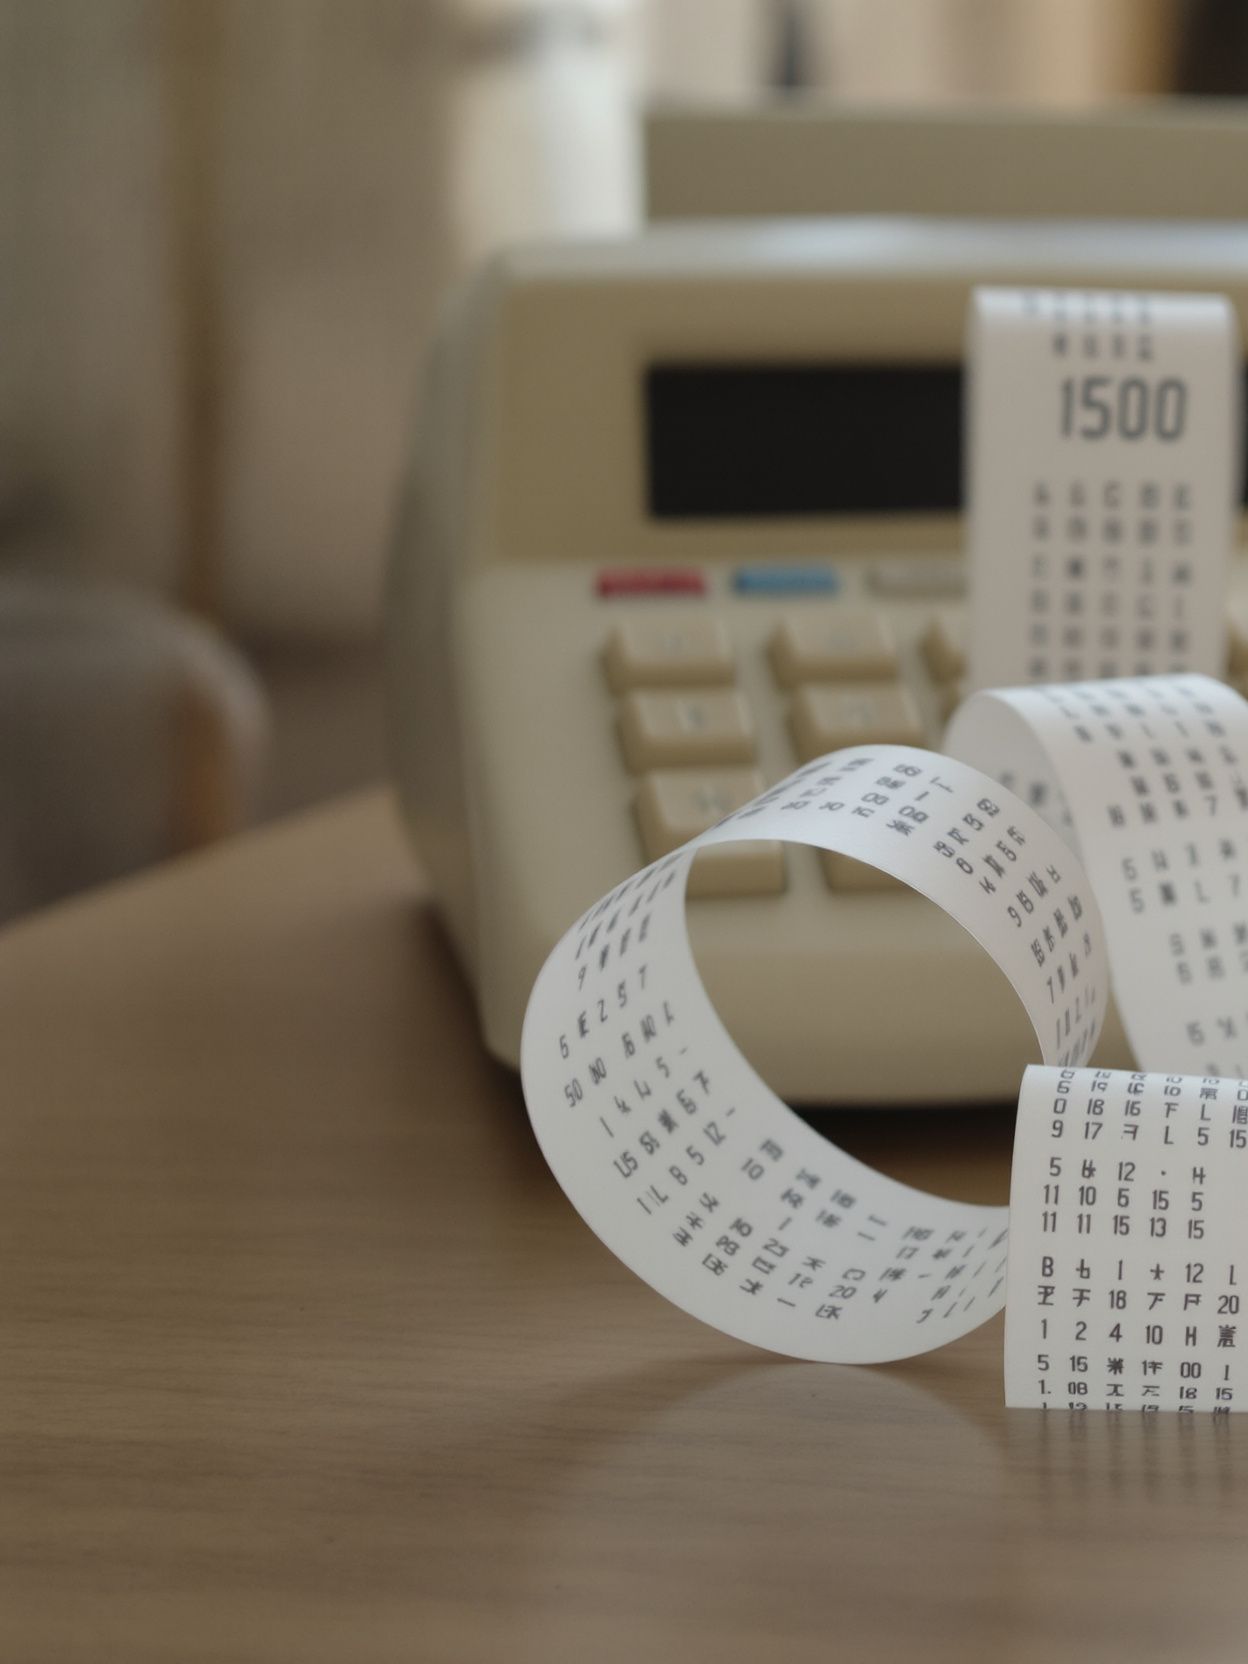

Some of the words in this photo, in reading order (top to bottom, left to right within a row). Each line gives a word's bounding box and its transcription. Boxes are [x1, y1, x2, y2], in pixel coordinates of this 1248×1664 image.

[1062, 376, 1187, 442] 1500
[1052, 1120, 1063, 1138] 9
[1085, 1122, 1103, 1139] 17
[1198, 1127, 1209, 1146] 5
[1230, 1129, 1246, 1148] 15
[1050, 1157, 1061, 1176] 5
[1118, 1162, 1135, 1181] 12
[1044, 1184, 1059, 1205] 11
[1079, 1186, 1096, 1206] 10
[1153, 1190, 1169, 1210] 15
[1192, 1192, 1203, 1211] 5
[1043, 1211, 1056, 1232] 11
[1077, 1213, 1091, 1234] 11
[1113, 1215, 1129, 1235] 15
[1150, 1217, 1166, 1237] 13
[1188, 1219, 1204, 1239] 15
[1186, 1263, 1204, 1283] 12
[1217, 1295, 1239, 1314] 20
[1041, 1319, 1047, 1339] 1
[1075, 1321, 1087, 1340] 2
[1109, 1323, 1122, 1342] 4
[1146, 1325, 1163, 1345] 10
[1186, 1326, 1197, 1346] H
[1038, 1354, 1049, 1371] 5
[1180, 1362, 1201, 1378] 00
